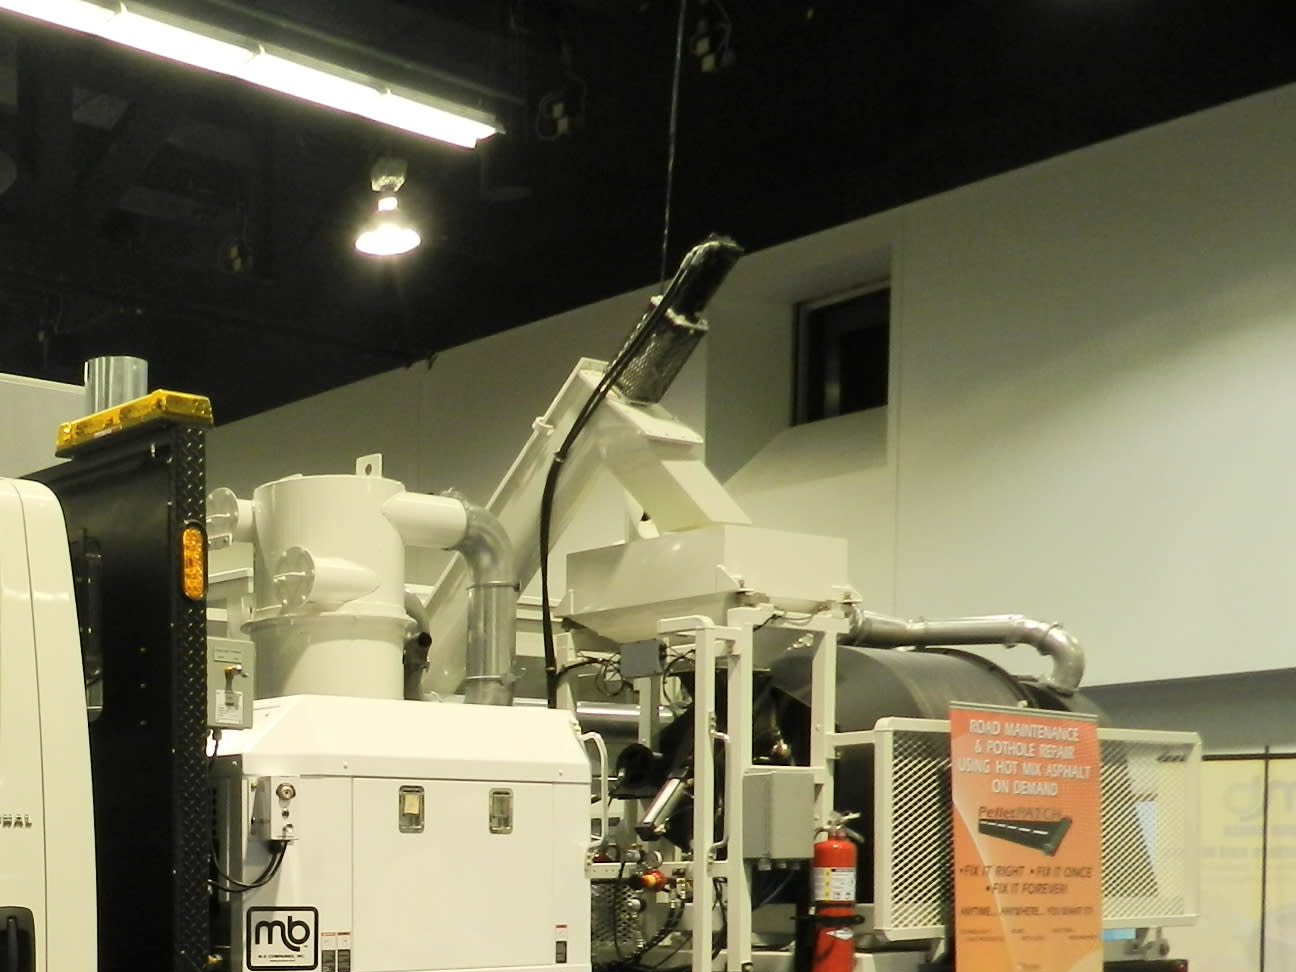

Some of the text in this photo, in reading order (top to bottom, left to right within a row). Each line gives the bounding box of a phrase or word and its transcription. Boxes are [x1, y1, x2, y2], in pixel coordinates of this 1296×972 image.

[970, 720, 1079, 741] ROAD MAINTENANCE
[988, 741, 1035, 757] POTHOLE
[1040, 745, 1074, 759] REPAIR
[959, 759, 1091, 779] USING HOT MIX ASPHALT
[992, 780, 1057, 796] ON DEMAND
